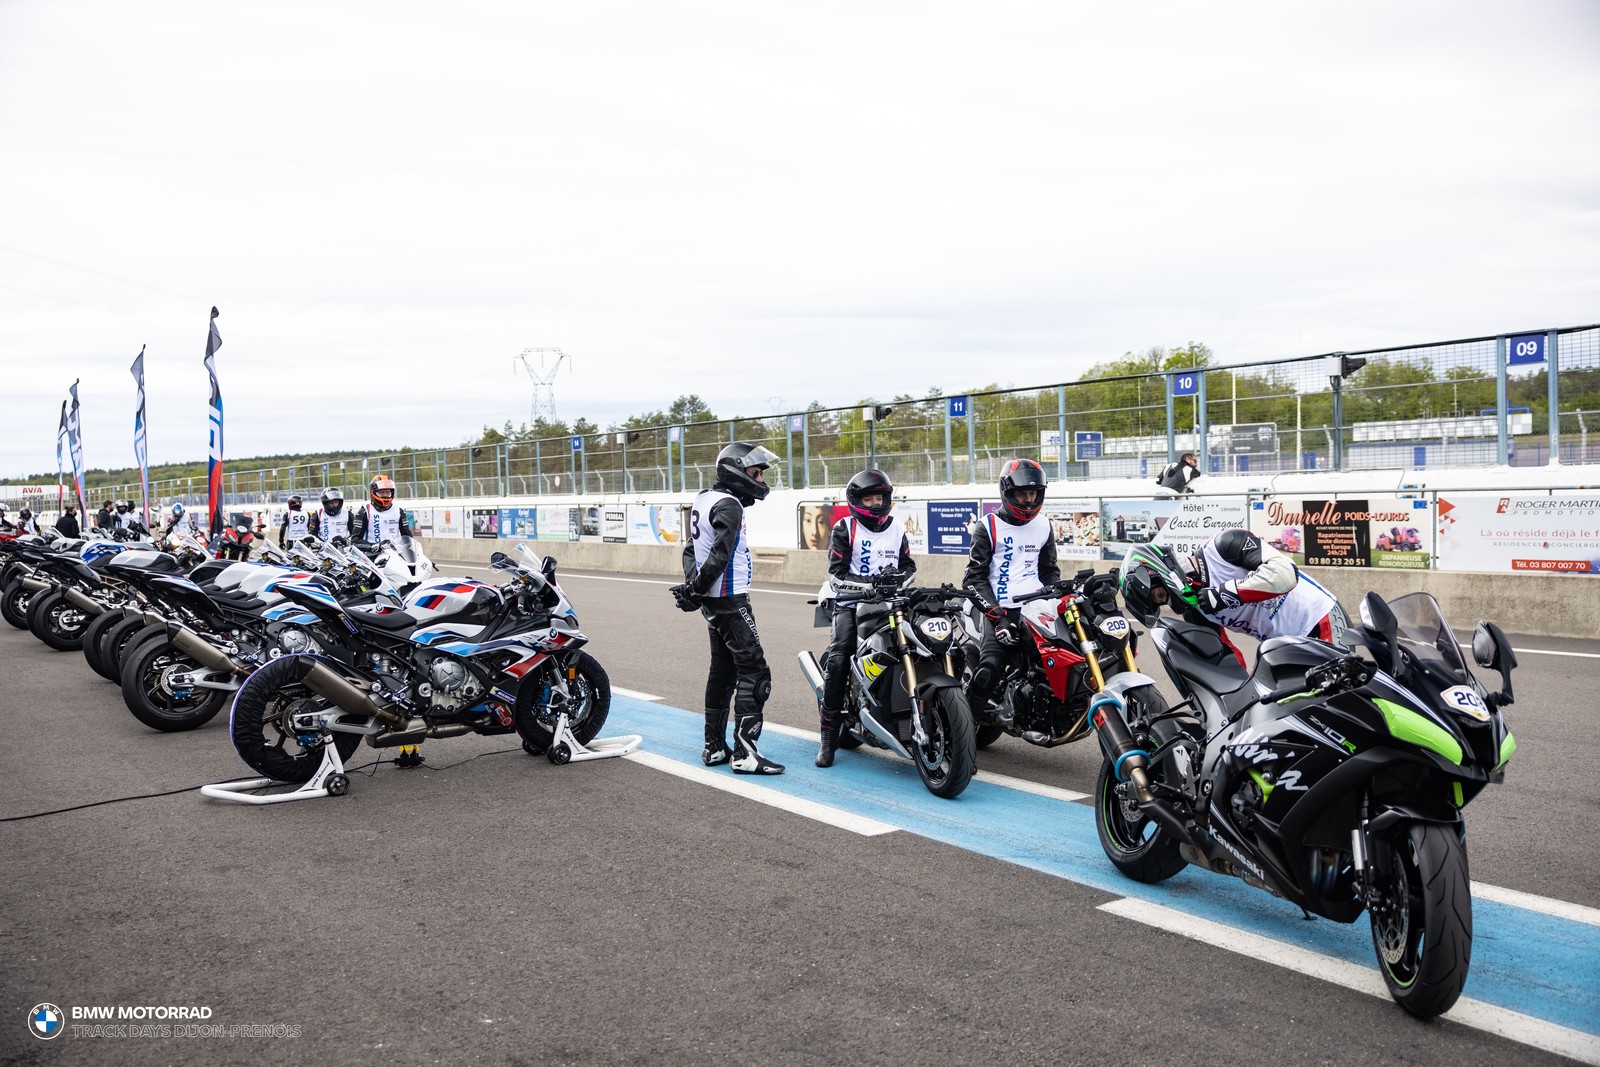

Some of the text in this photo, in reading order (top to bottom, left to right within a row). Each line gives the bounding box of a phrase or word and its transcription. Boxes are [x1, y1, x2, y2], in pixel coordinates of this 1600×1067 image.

[1516, 341, 1538, 356] 09
[1179, 376, 1192, 389] 10
[954, 402, 963, 412] 11
[793, 417, 801, 427] 12
[1183, 503, 1205, 512] Hôtel
[1515, 500, 1557, 508] ROGER
[1267, 501, 1410, 527] Daurelle POIDS-LOURDS
[292, 515, 306, 525] 59
[1169, 516, 1245, 532] Castel Burgond
[1480, 529, 1493, 537] Là
[1499, 529, 1510, 537] où
[1513, 528, 1548, 538] réside
[1551, 529, 1577, 539] déjà
[1580, 529, 1591, 538] le
[1177, 543, 1188, 553] 80
[859, 540, 872, 576] DAYS
[1309, 557, 1366, 566] 03 80 23 20 51
[1381, 554, 1423, 562] DEPANNEUSE
[996, 536, 1014, 602] TRACKDAYS
[1378, 560, 1426, 568] REMORQUEUSE
[1575, 562, 1586, 570] 70
[927, 621, 948, 632] 210
[1106, 620, 1127, 632] 209
[1208, 824, 1265, 881] Kawasaki
